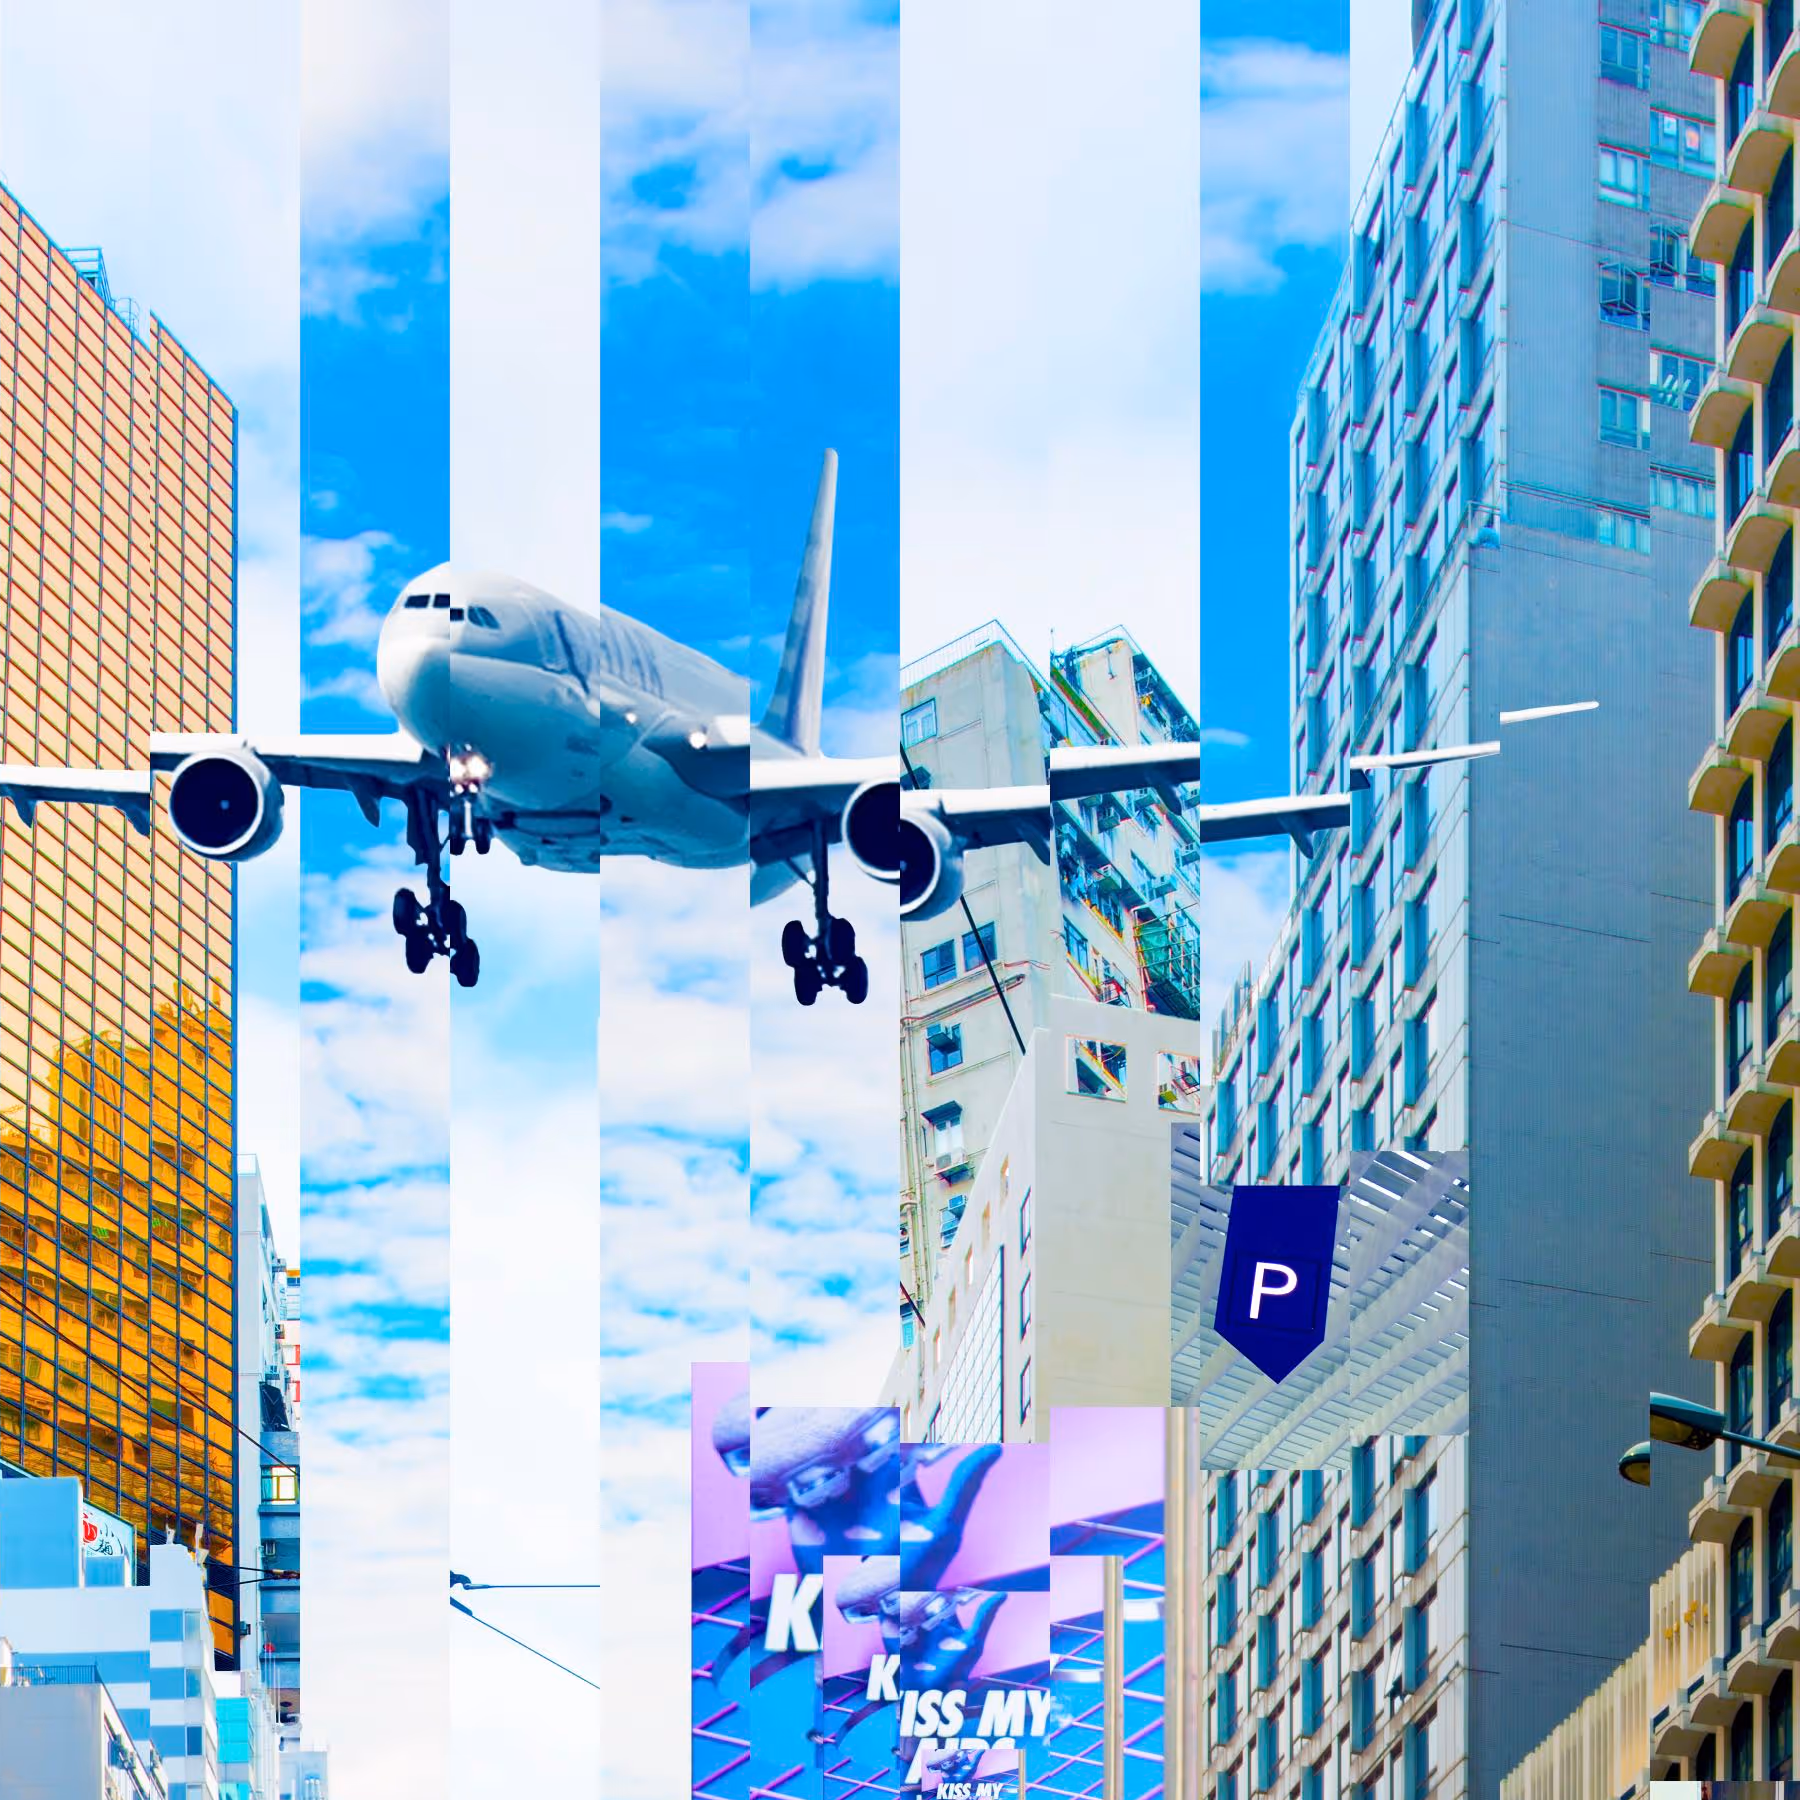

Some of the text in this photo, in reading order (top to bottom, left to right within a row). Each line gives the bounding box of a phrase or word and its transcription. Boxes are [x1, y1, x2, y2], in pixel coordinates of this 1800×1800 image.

[1249, 1262, 1297, 1319] P
[976, 1690, 1050, 1737] MY
[937, 1783, 1003, 1800] KISS MY
